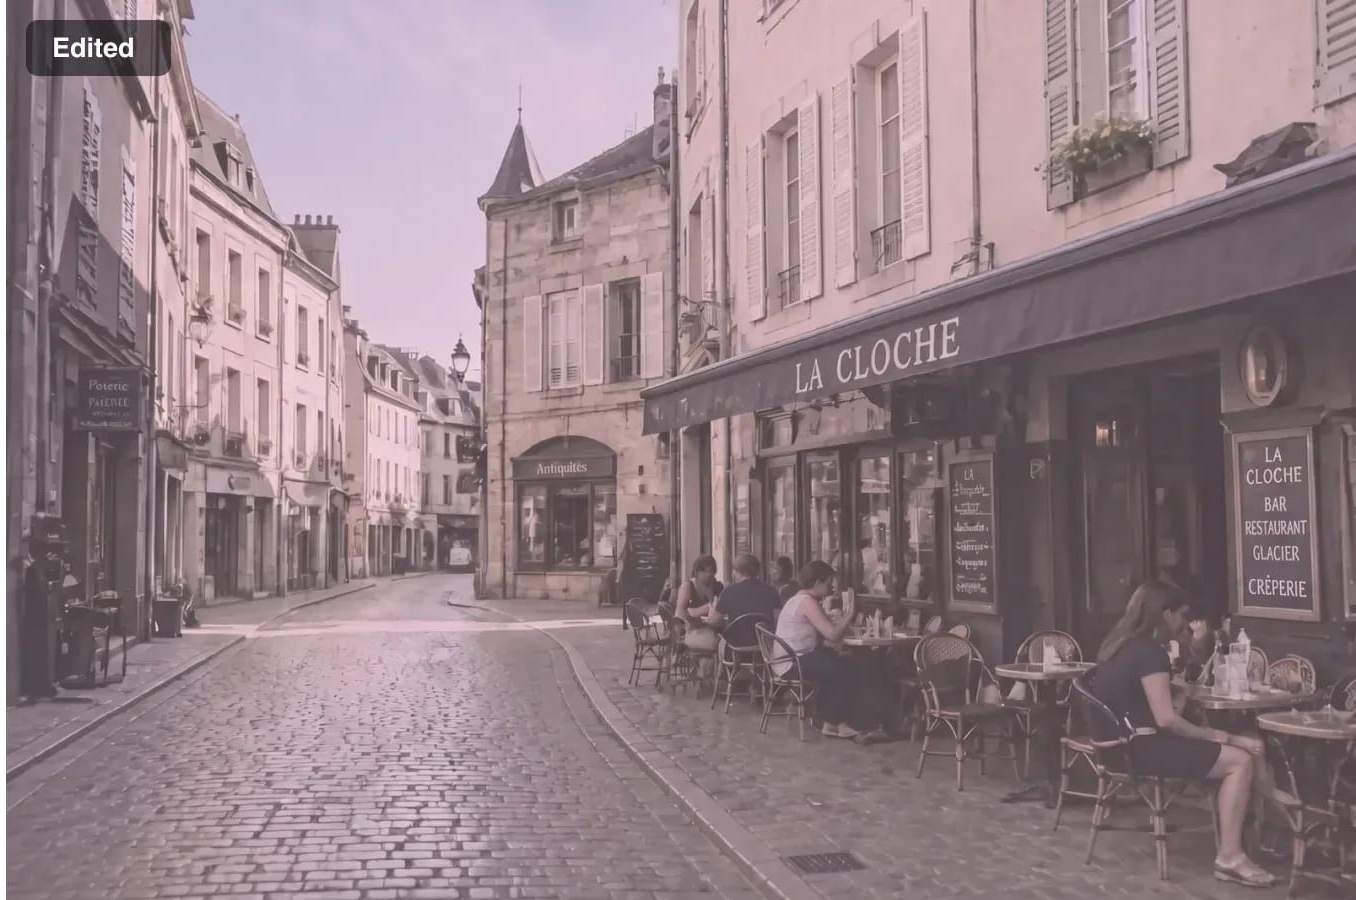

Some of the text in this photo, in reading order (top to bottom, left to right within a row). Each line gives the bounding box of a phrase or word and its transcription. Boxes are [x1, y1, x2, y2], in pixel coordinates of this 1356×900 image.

[795, 316, 961, 394] LA CLOCHE
[1265, 446, 1282, 463] LA
[536, 461, 588, 477] Antiquités
[1246, 466, 1303, 485] CLOCHE
[1264, 496, 1287, 512] BAR
[1245, 520, 1307, 535] RESTAURANT
[1253, 544, 1300, 561] GLACIER
